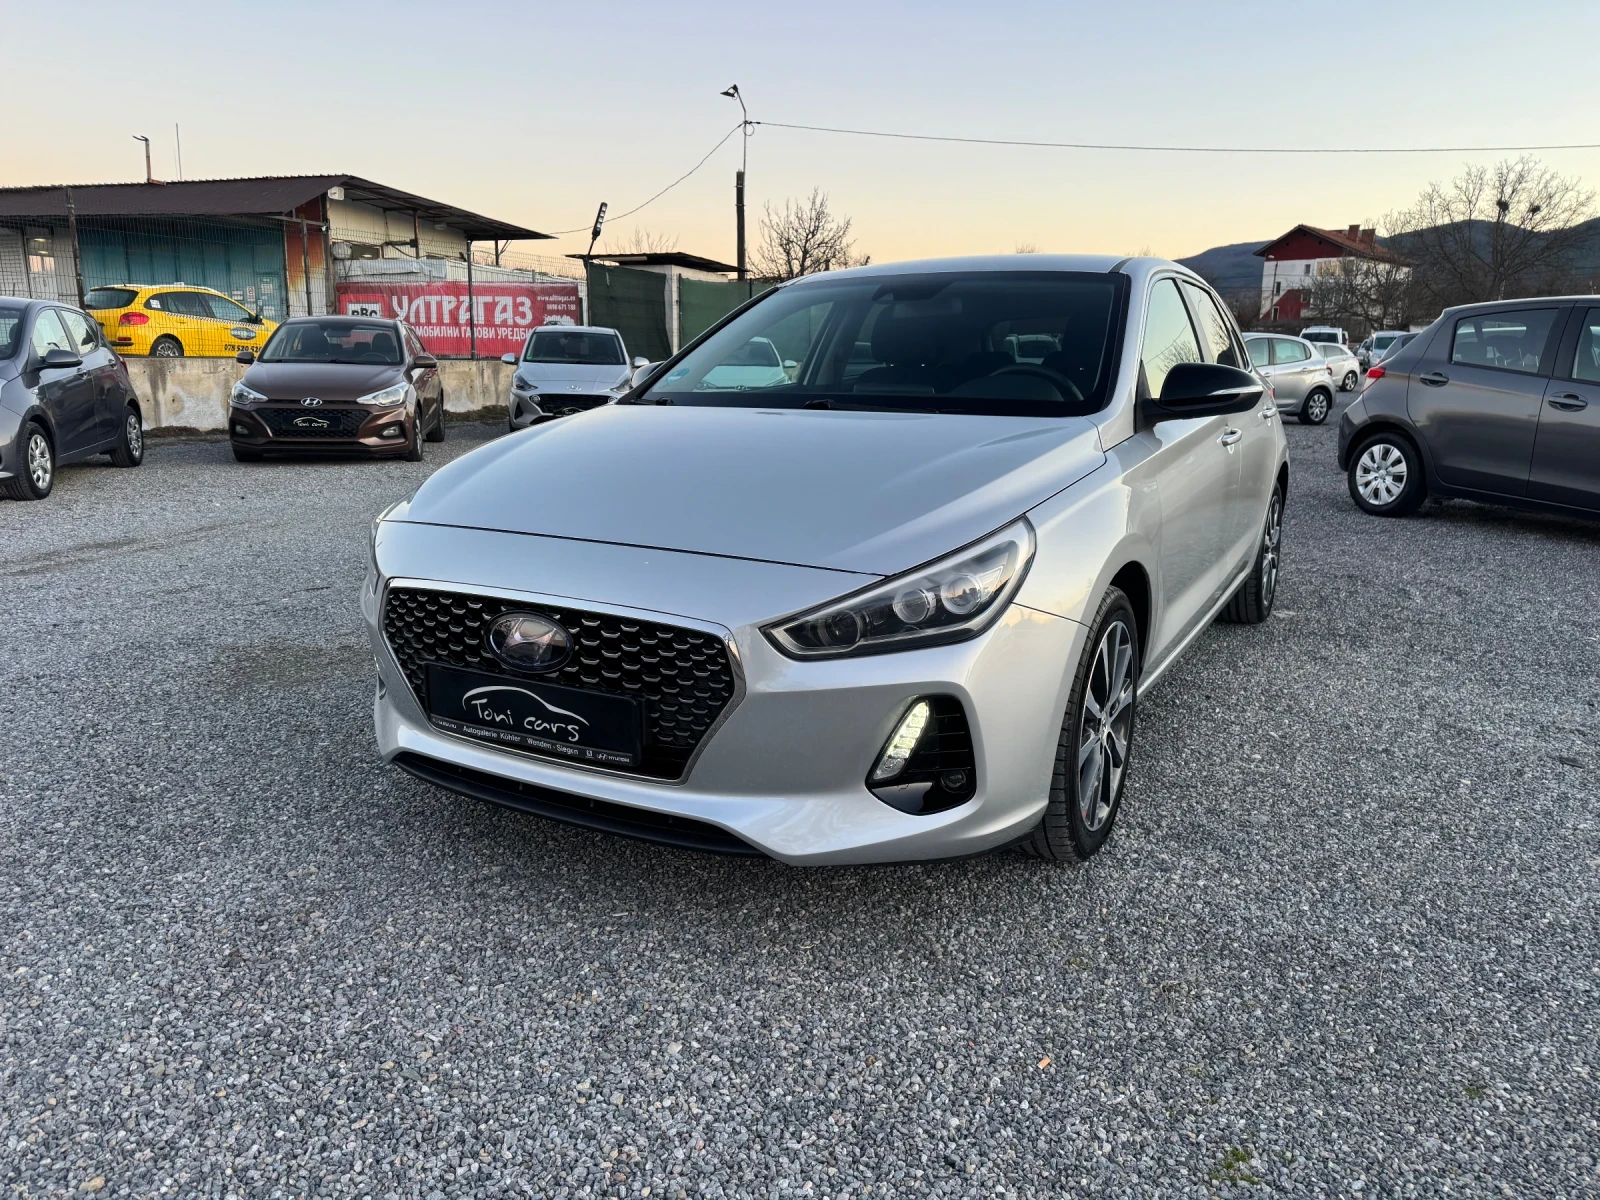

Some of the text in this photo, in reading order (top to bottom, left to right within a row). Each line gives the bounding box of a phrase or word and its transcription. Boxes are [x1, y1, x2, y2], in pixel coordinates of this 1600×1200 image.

[391, 295, 533, 325] УЛТРАГАЗ
[411, 325, 460, 338] МОБИЛНИ
[470, 698, 580, 742] Toni cars
[462, 725, 498, 739] Autogalerie
[526, 737, 552, 750] Wenden
[556, 744, 579, 756] Siegen
